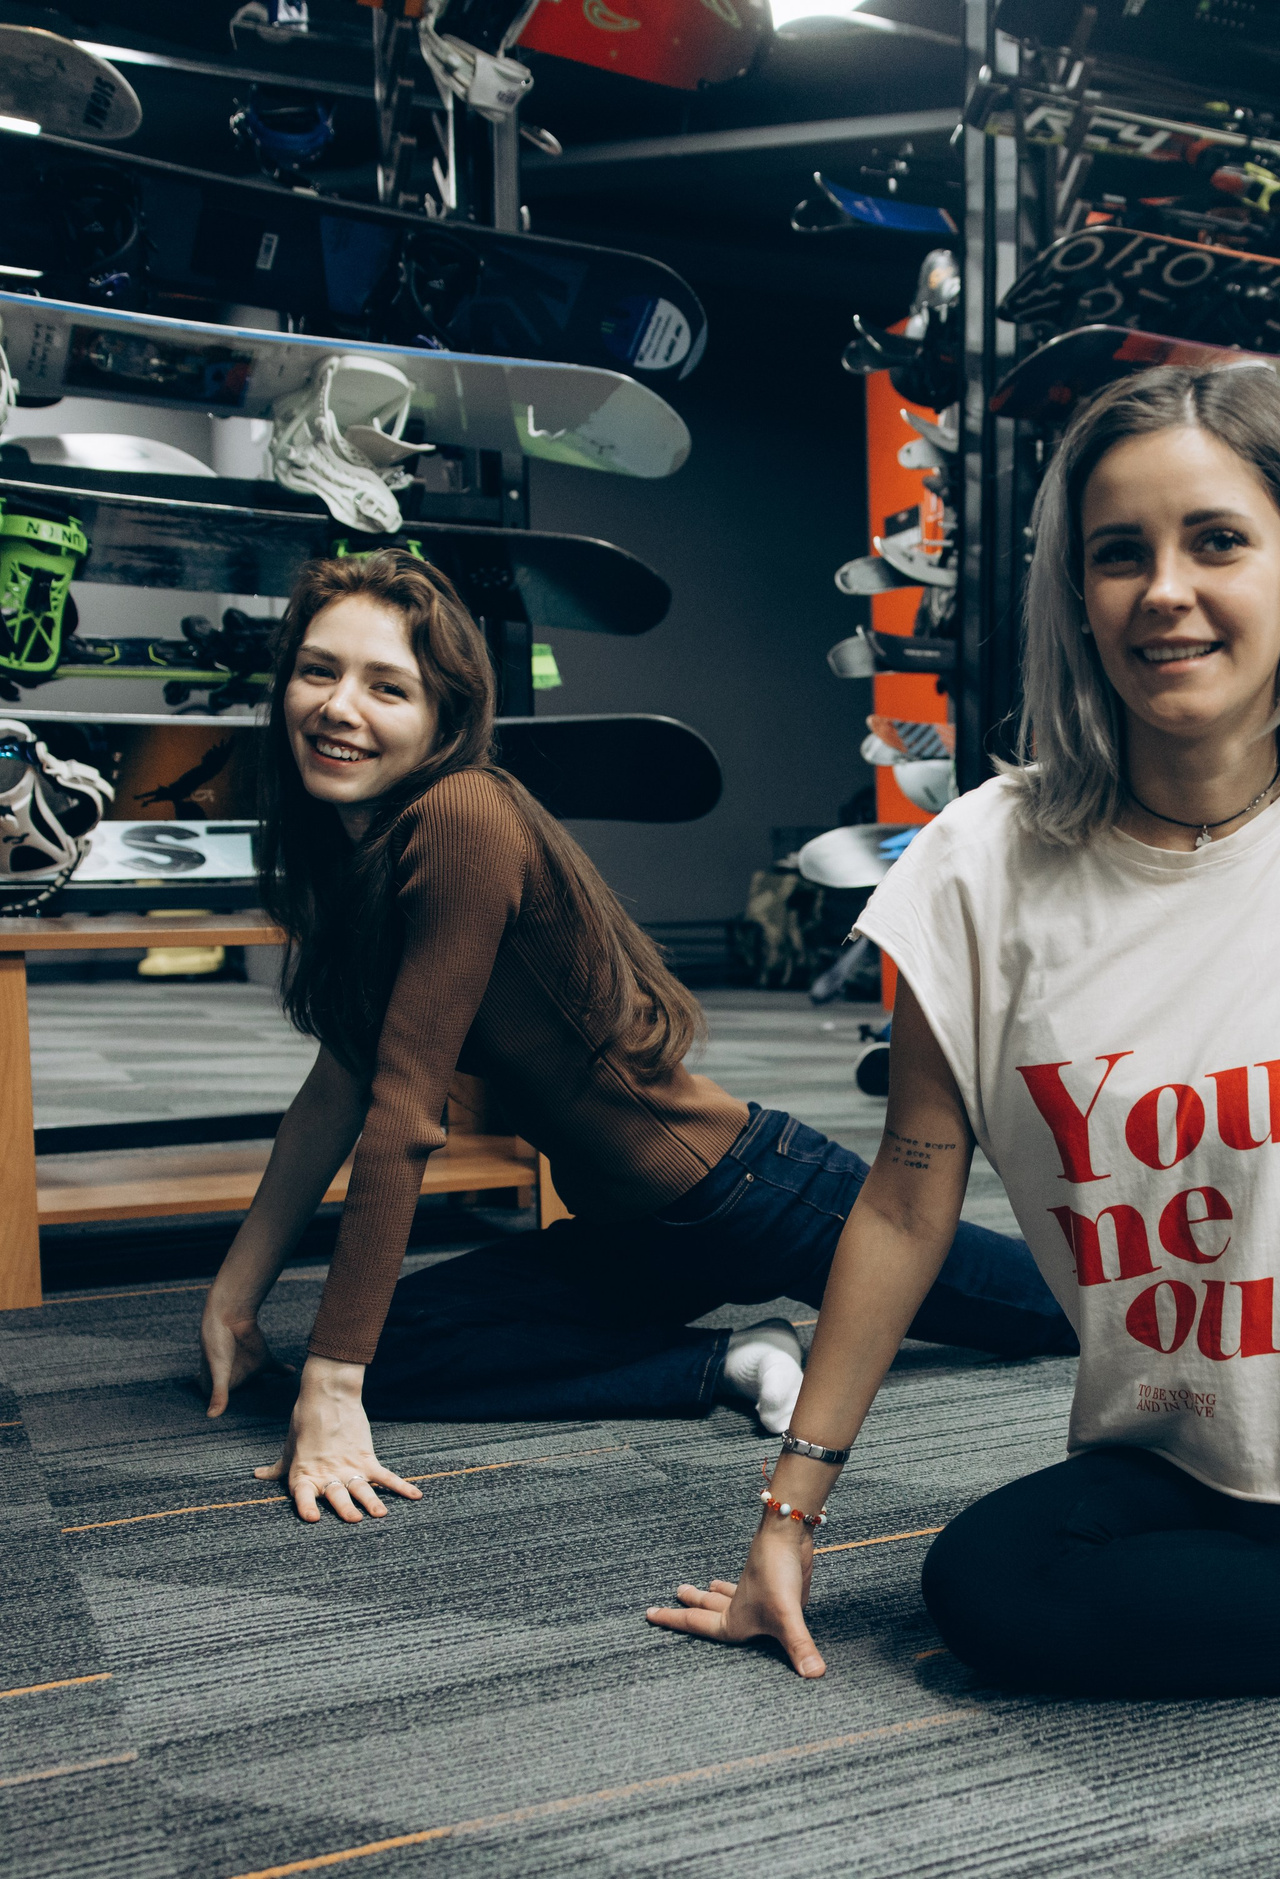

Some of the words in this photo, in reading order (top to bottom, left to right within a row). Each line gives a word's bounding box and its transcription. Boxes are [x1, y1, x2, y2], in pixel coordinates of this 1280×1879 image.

[1046, 1186, 1233, 1287] me
[1138, 1383, 1152, 1398] TO
[1152, 1387, 1166, 1401] BE
[1136, 1399, 1161, 1413] AND
[1163, 1401, 1181, 1412] IN
[1184, 1400, 1215, 1418] LVE
